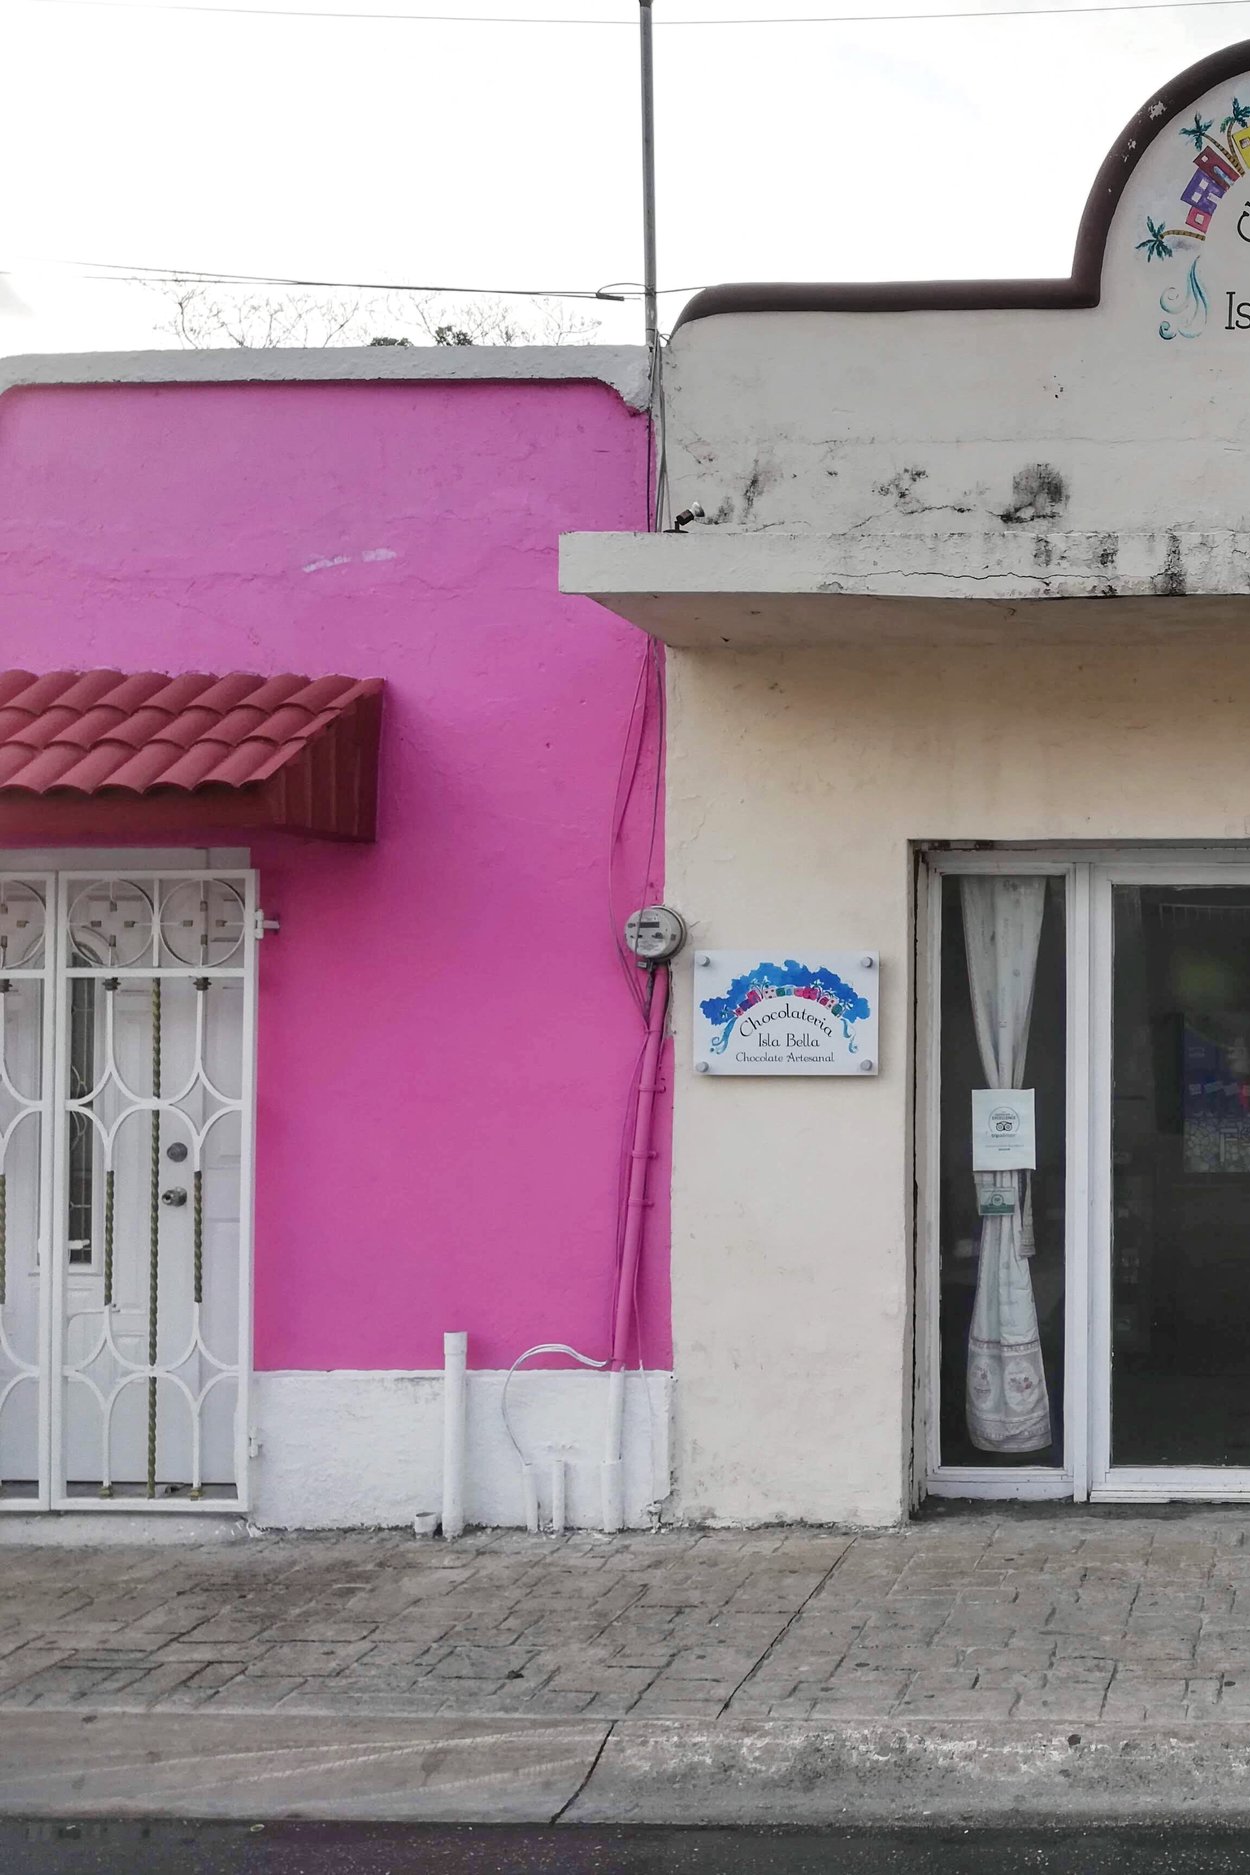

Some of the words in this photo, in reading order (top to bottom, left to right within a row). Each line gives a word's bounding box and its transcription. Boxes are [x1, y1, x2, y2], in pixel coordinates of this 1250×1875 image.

[739, 1003, 833, 1038] Chocolateria
[759, 1033, 780, 1048] Isla
[787, 1033, 820, 1048] Bella
[735, 1052, 784, 1063] Chocolate
[787, 1052, 835, 1063] Artesanal
